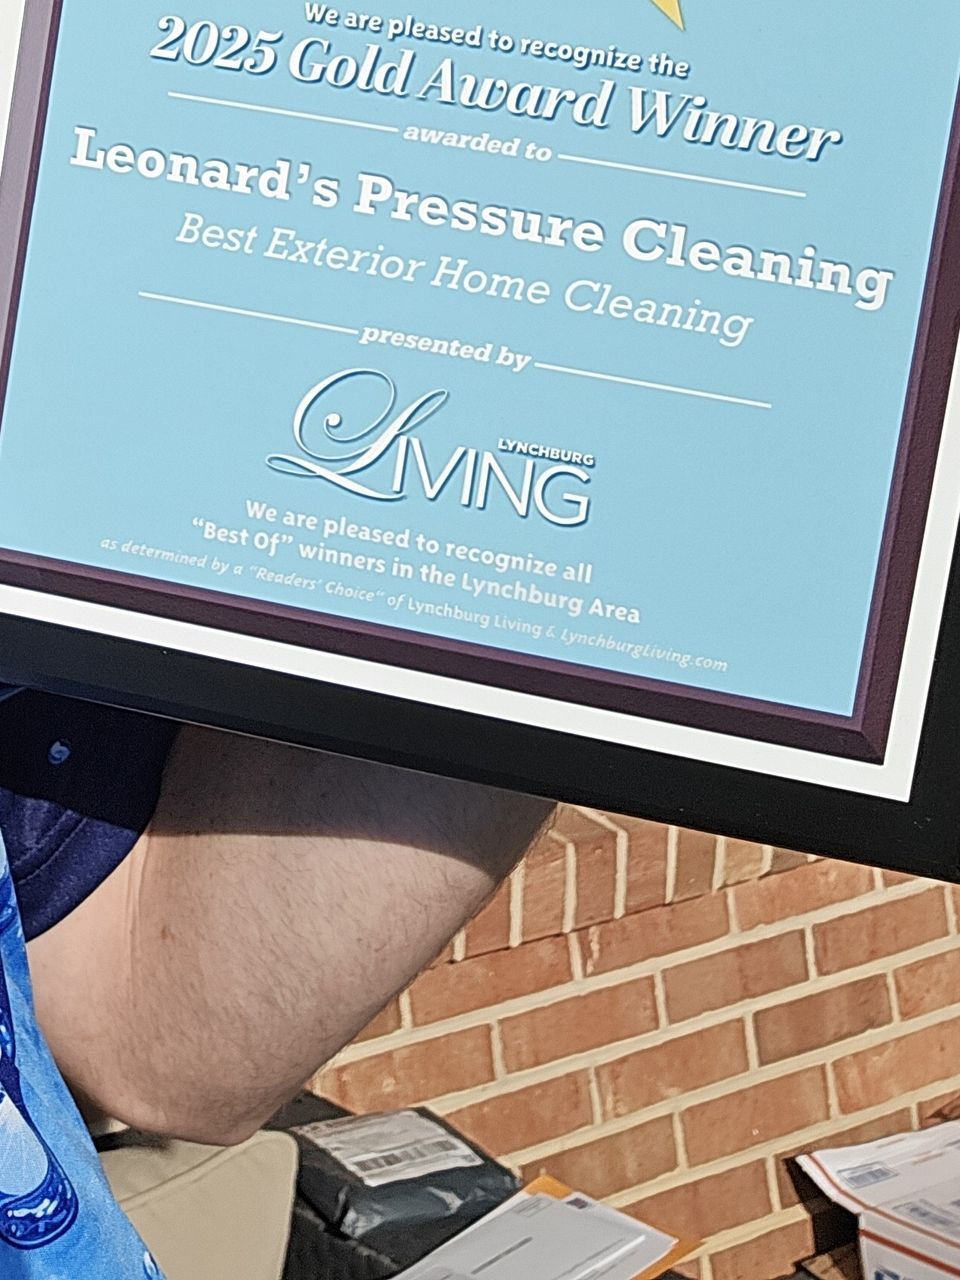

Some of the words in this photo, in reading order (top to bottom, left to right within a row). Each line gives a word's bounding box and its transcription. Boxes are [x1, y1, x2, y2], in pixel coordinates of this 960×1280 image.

[304, 2, 339, 25] We
[344, 11, 382, 31] are
[387, 16, 482, 48] pleased
[488, 30, 515, 51] to
[520, 38, 643, 71] recognize
[648, 53, 690, 78] the
[149, 15, 283, 75] 2025
[288, 37, 416, 98] Gold
[416, 57, 616, 129] Award
[628, 86, 842, 161] Winner
[403, 124, 520, 158] awarded
[524, 143, 553, 162] to
[175, 211, 258, 255] Best
[263, 226, 427, 285] Exterior
[430, 256, 551, 305] Home
[564, 278, 754, 349] Cleaning
[353, 172, 606, 253] Pressure
[622, 218, 894, 312] Cleaning
[358, 326, 493, 364] presented
[495, 346, 533, 373] by
[497, 438, 595, 467] LYNCHBURG
[245, 500, 278, 522] We
[282, 510, 318, 531] are
[323, 515, 411, 550] pleased
[416, 534, 440, 554] to
[445, 542, 558, 578] recognize
[562, 562, 594, 584] all
[100, 536, 117, 551] as
[121, 539, 207, 569] determined
[211, 557, 230, 576] by
[233, 563, 244, 576] a
[387, 593, 406, 614] of
[408, 595, 490, 628] Lynchburg
[494, 614, 543, 639] Living
[545, 625, 557, 639] &
[560, 628, 730, 672] LynchburgLiving.com
[298, 543, 387, 574] winners
[391, 558, 415, 579] in
[419, 566, 456, 588] the
[461, 573, 584, 617] Lynchburg
[588, 598, 641, 624] Area
